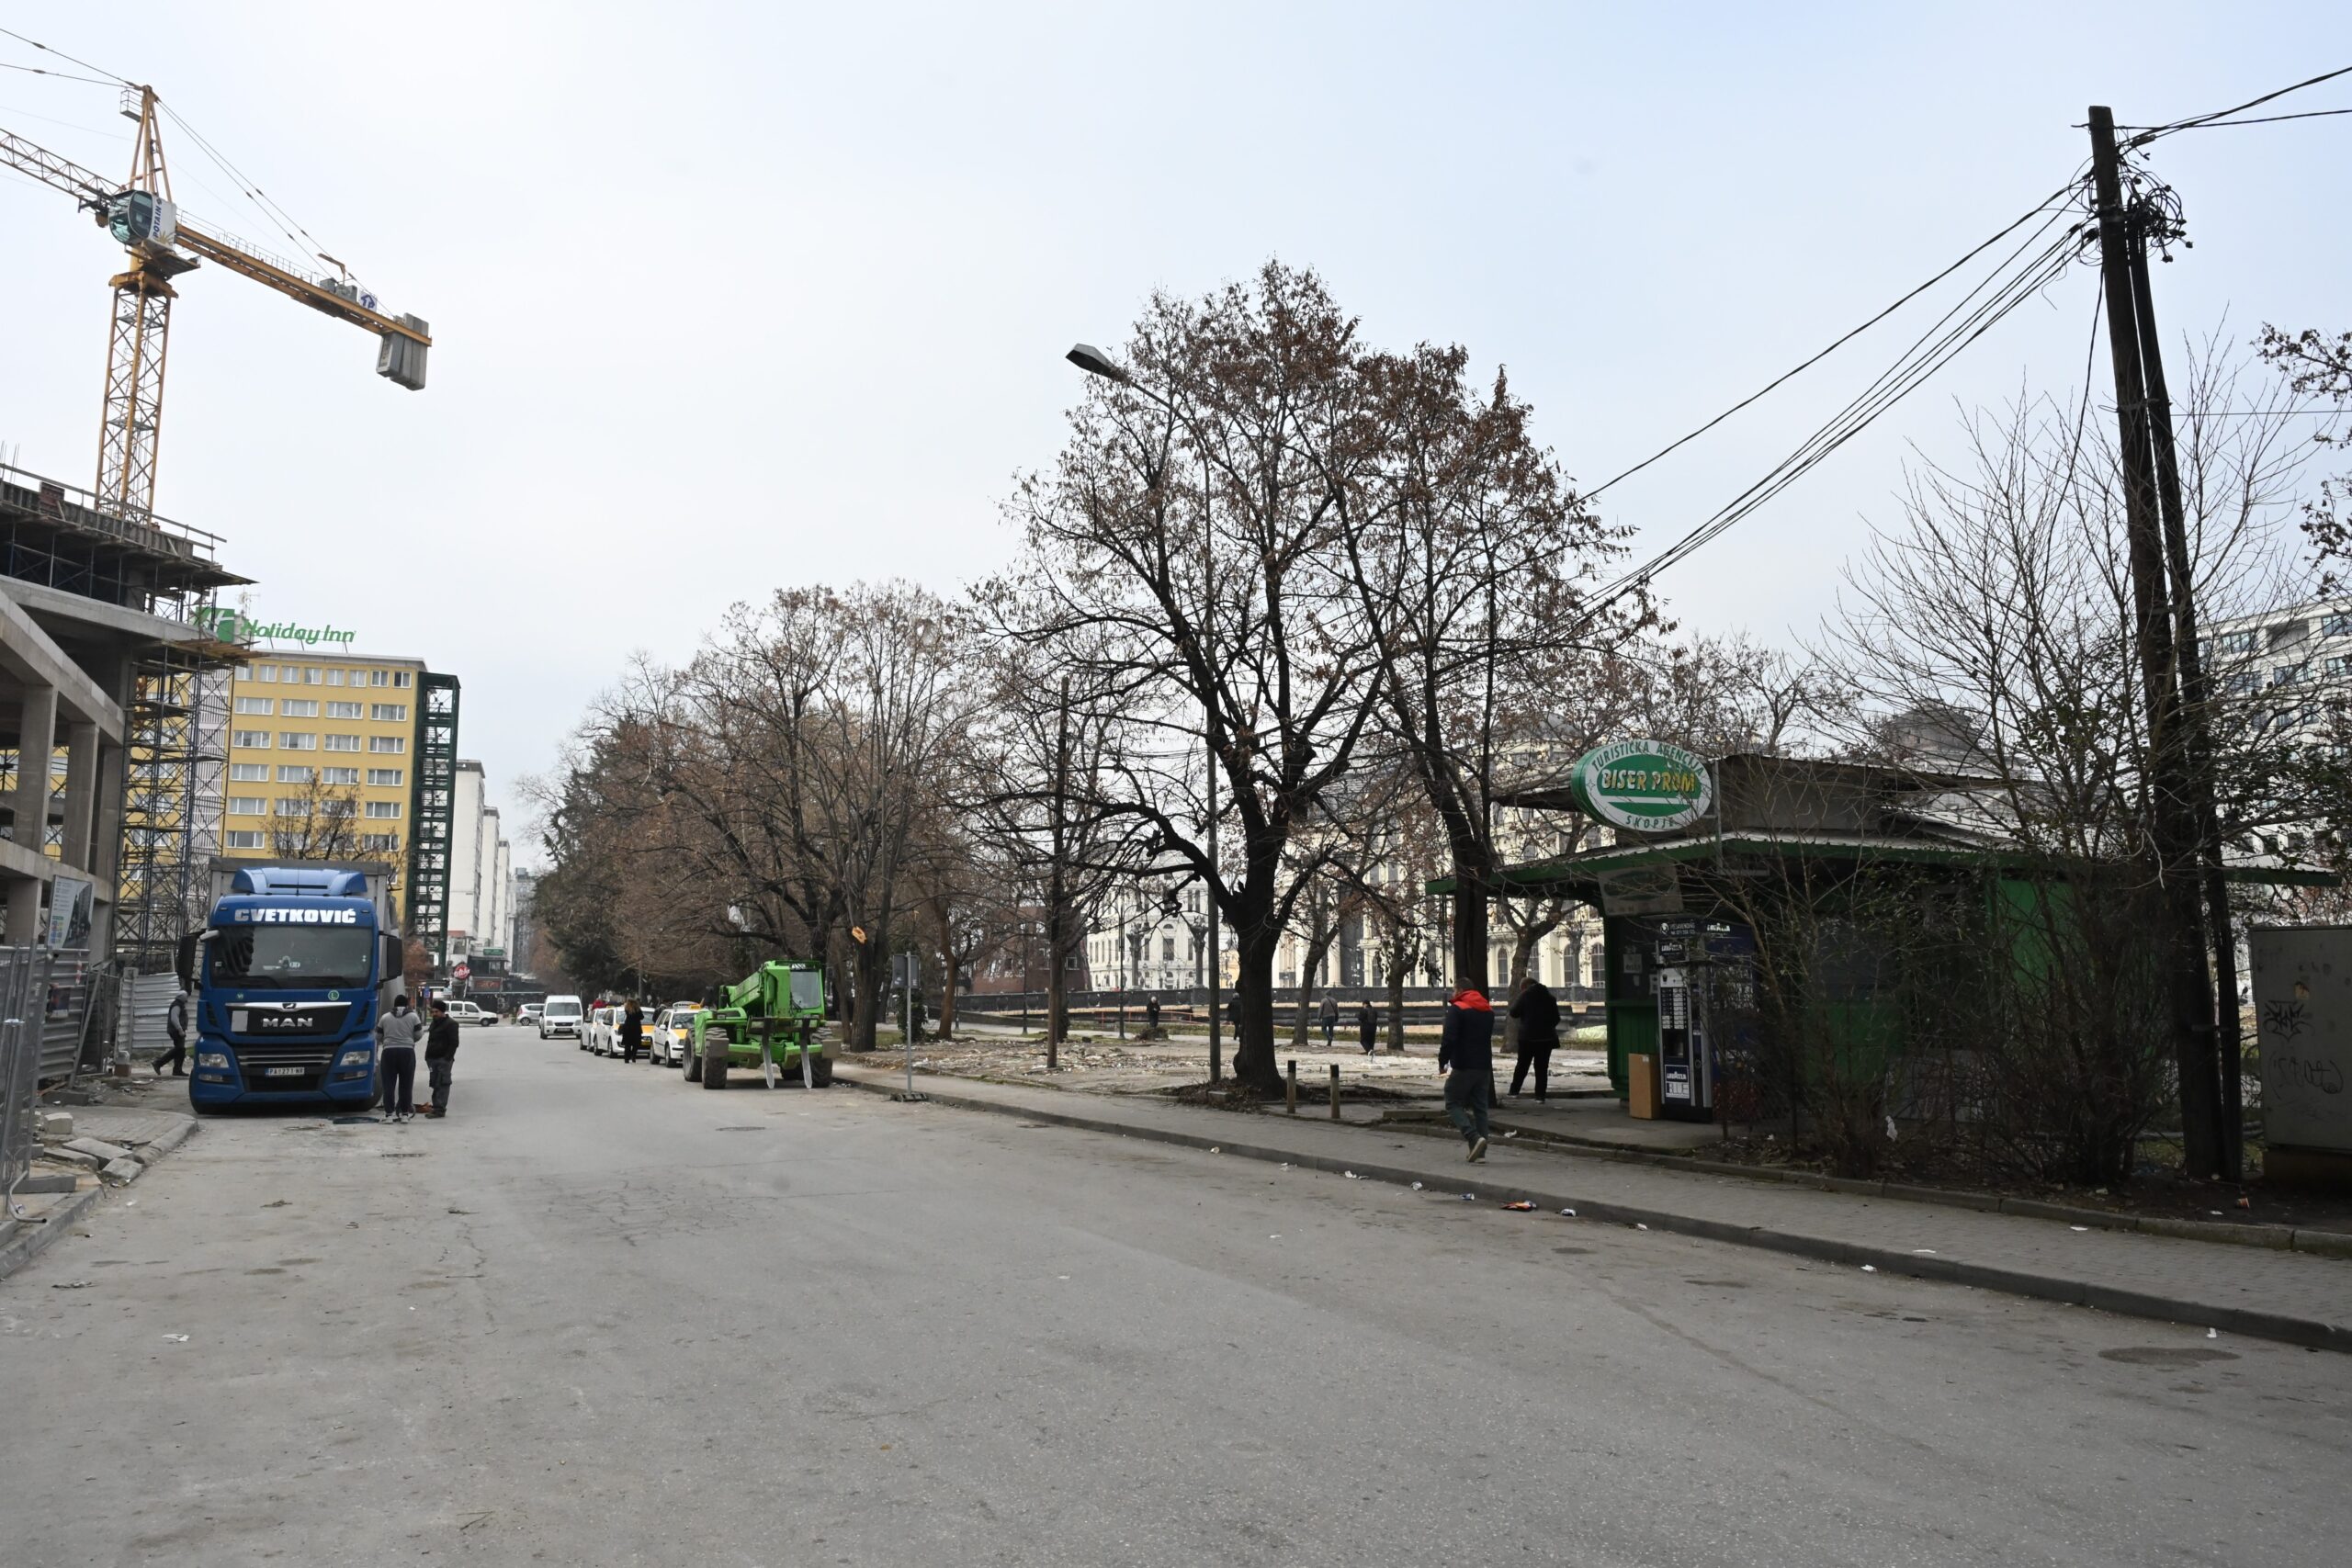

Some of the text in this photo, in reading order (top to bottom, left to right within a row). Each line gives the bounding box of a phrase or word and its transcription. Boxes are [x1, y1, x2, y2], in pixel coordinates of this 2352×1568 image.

[153, 206, 162, 239] POTAIN
[240, 619, 356, 645] Holiday Inn
[1657, 742, 1704, 776] AGENCIJA
[1601, 769, 1696, 793] BISER PROM
[1625, 815, 1675, 829] SKOPJE
[234, 908, 356, 924] CVETKOVIĆ
[262, 1017, 313, 1028] MAN
